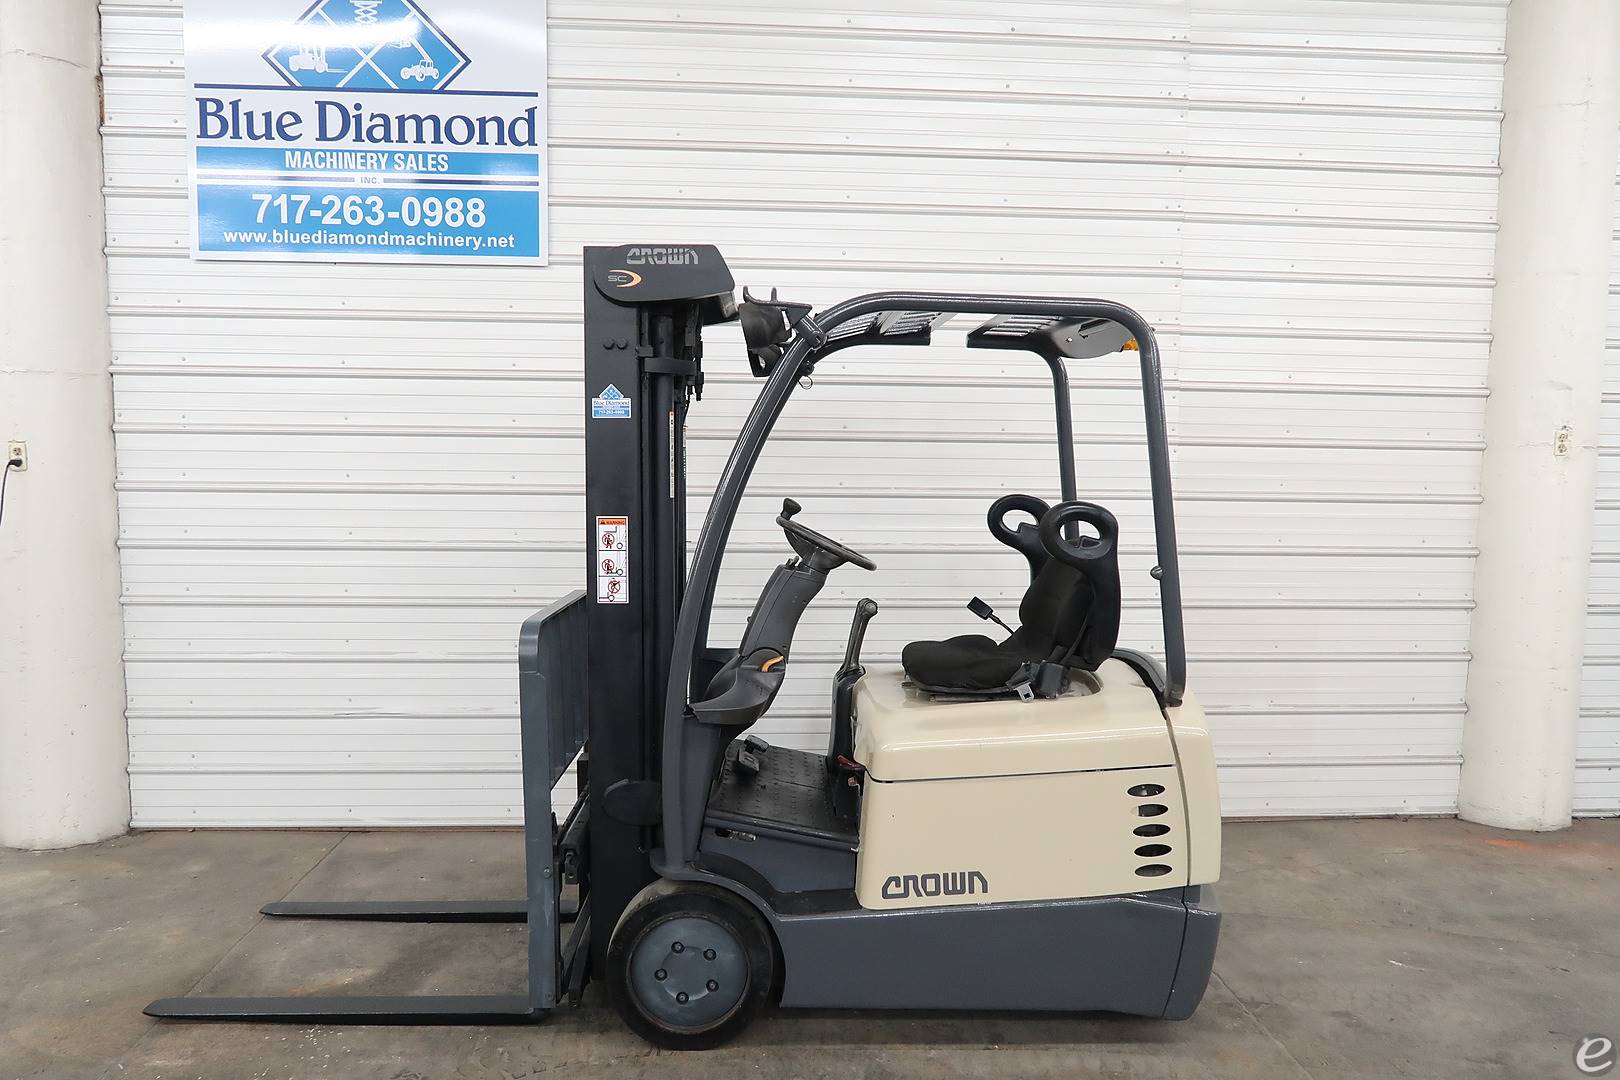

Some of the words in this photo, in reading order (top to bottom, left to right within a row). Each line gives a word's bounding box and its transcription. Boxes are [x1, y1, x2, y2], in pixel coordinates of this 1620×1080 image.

[195, 97, 303, 142] Blue
[314, 100, 538, 147] Diamond
[285, 150, 388, 172] MACHINERY
[394, 152, 449, 172] SALES
[360, 176, 381, 185] INC.
[252, 193, 487, 229] 717-263-0988
[223, 229, 515, 250] www.bluediamondmachinery.net
[626, 247, 699, 265] CROWN
[882, 871, 988, 899] CROWN
